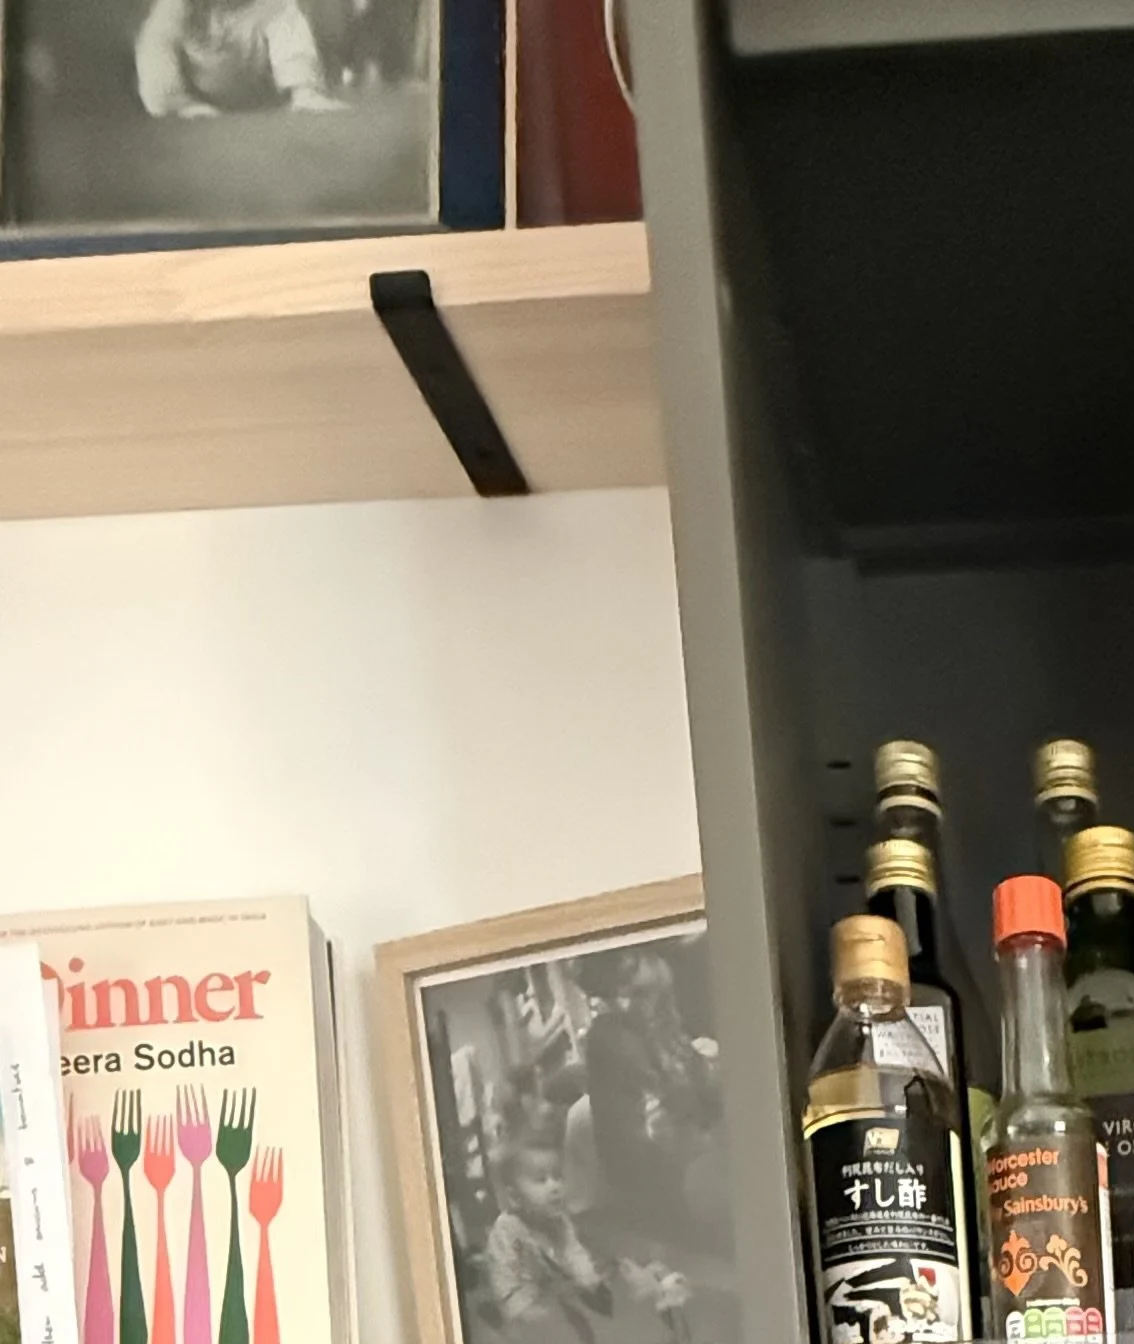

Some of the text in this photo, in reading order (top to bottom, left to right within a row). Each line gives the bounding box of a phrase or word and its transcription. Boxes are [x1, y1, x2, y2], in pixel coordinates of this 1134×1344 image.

[133, 1040, 236, 1071] Sodha
[843, 1178, 928, 1211] すし酢
[1003, 1196, 1089, 1217] Sainsbury's
